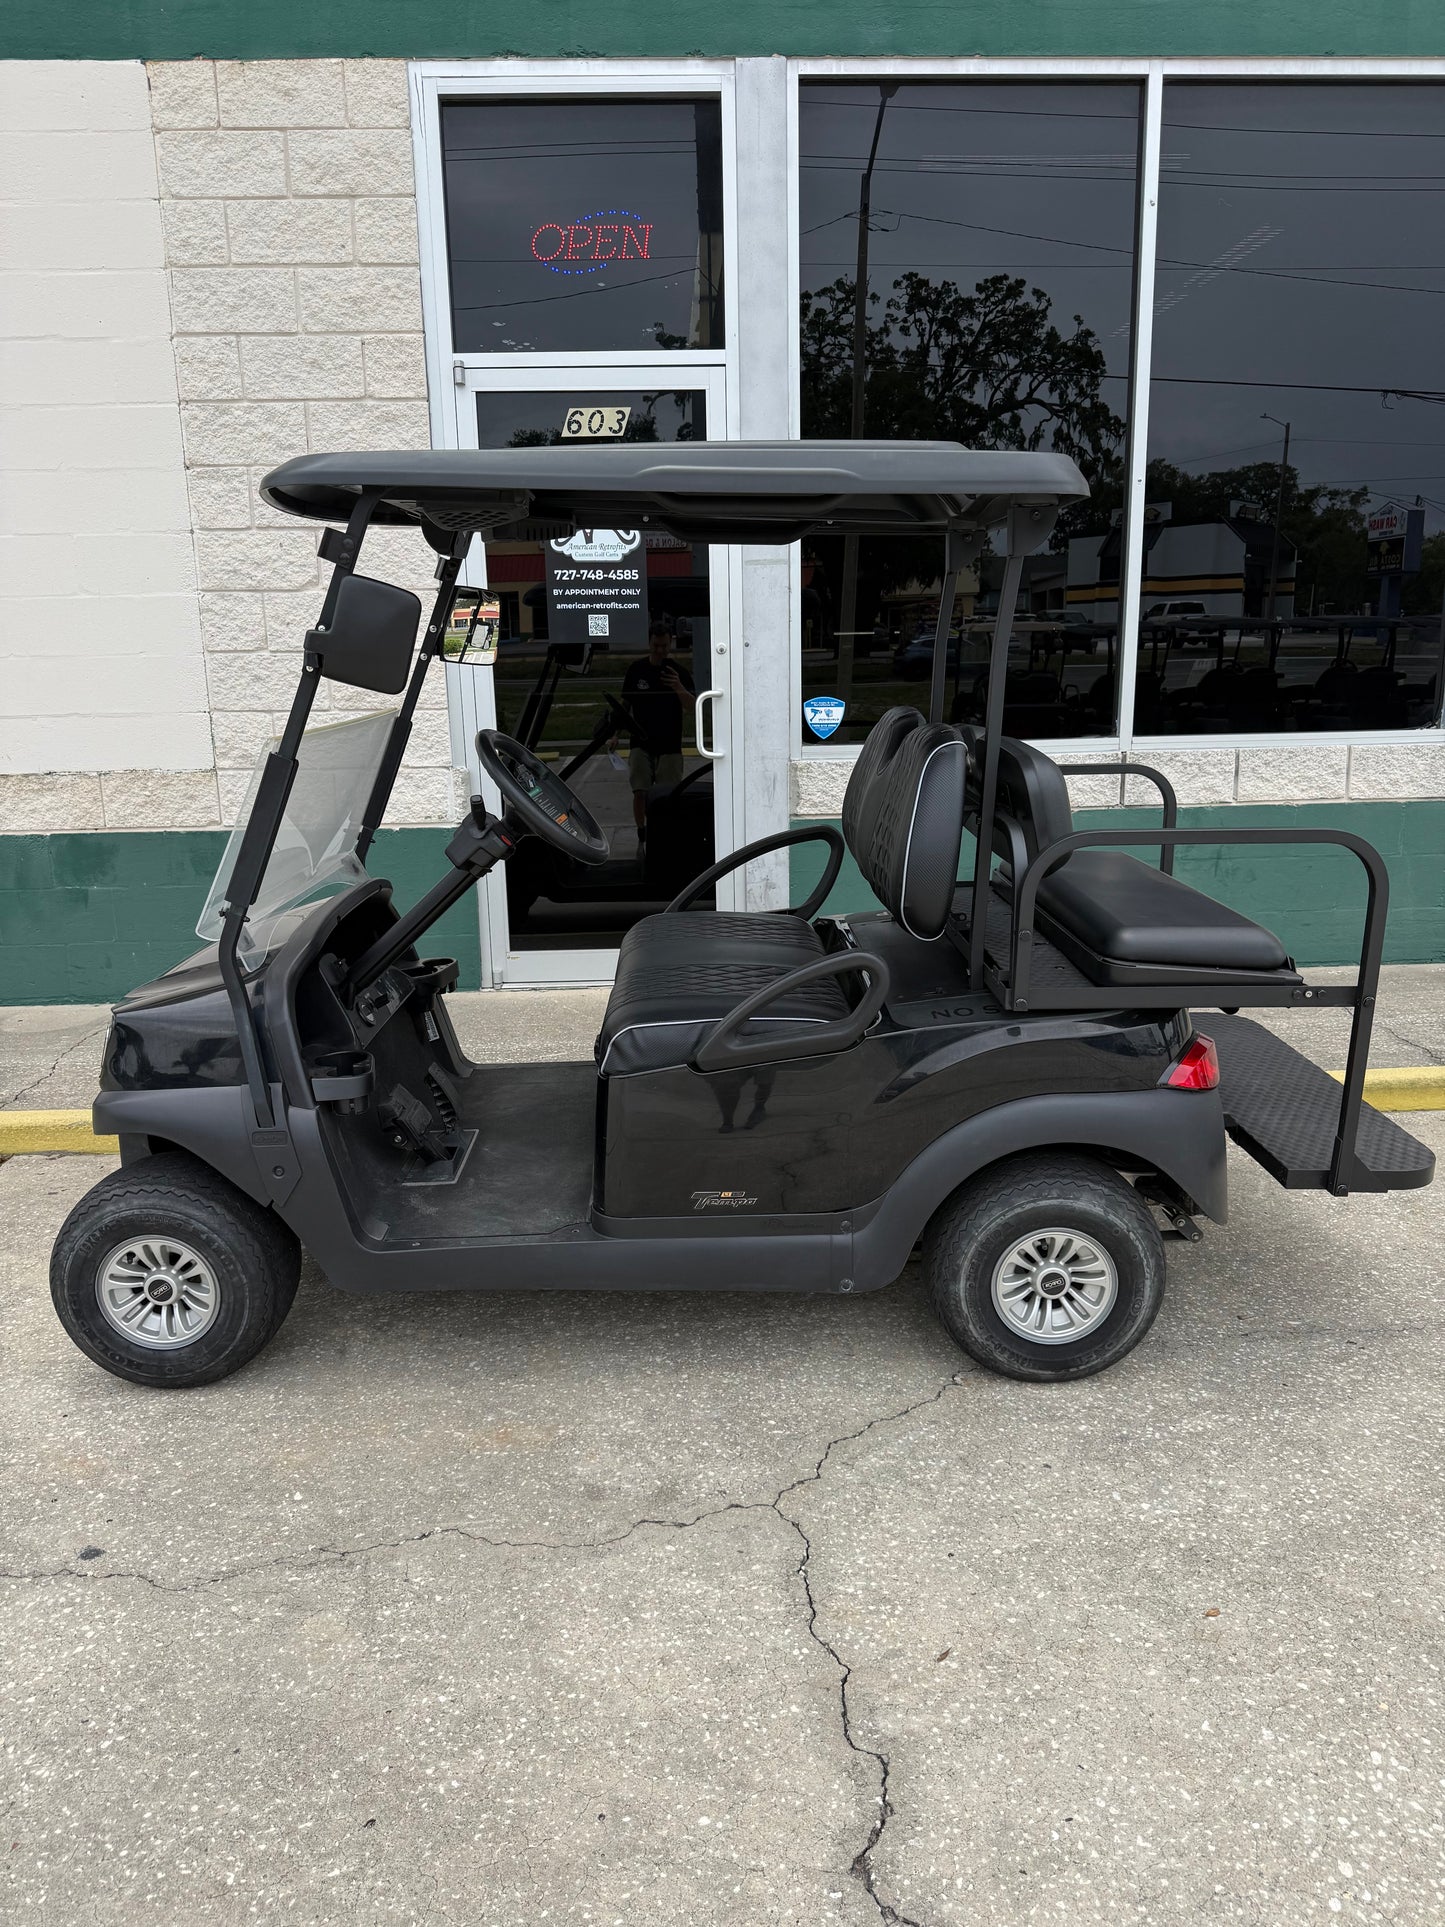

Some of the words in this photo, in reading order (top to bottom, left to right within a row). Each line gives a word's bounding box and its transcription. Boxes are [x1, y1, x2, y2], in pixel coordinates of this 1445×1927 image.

[531, 223, 653, 261] OPEN
[566, 409, 627, 435] 603
[567, 543, 597, 551] American
[599, 542, 627, 552] Retrofits
[554, 569, 639, 580] 727-748-4585
[553, 588, 563, 596] BY
[564, 588, 619, 596] APPOINTMENT
[620, 588, 641, 596] ONLY
[930, 1007, 974, 1019] NO
